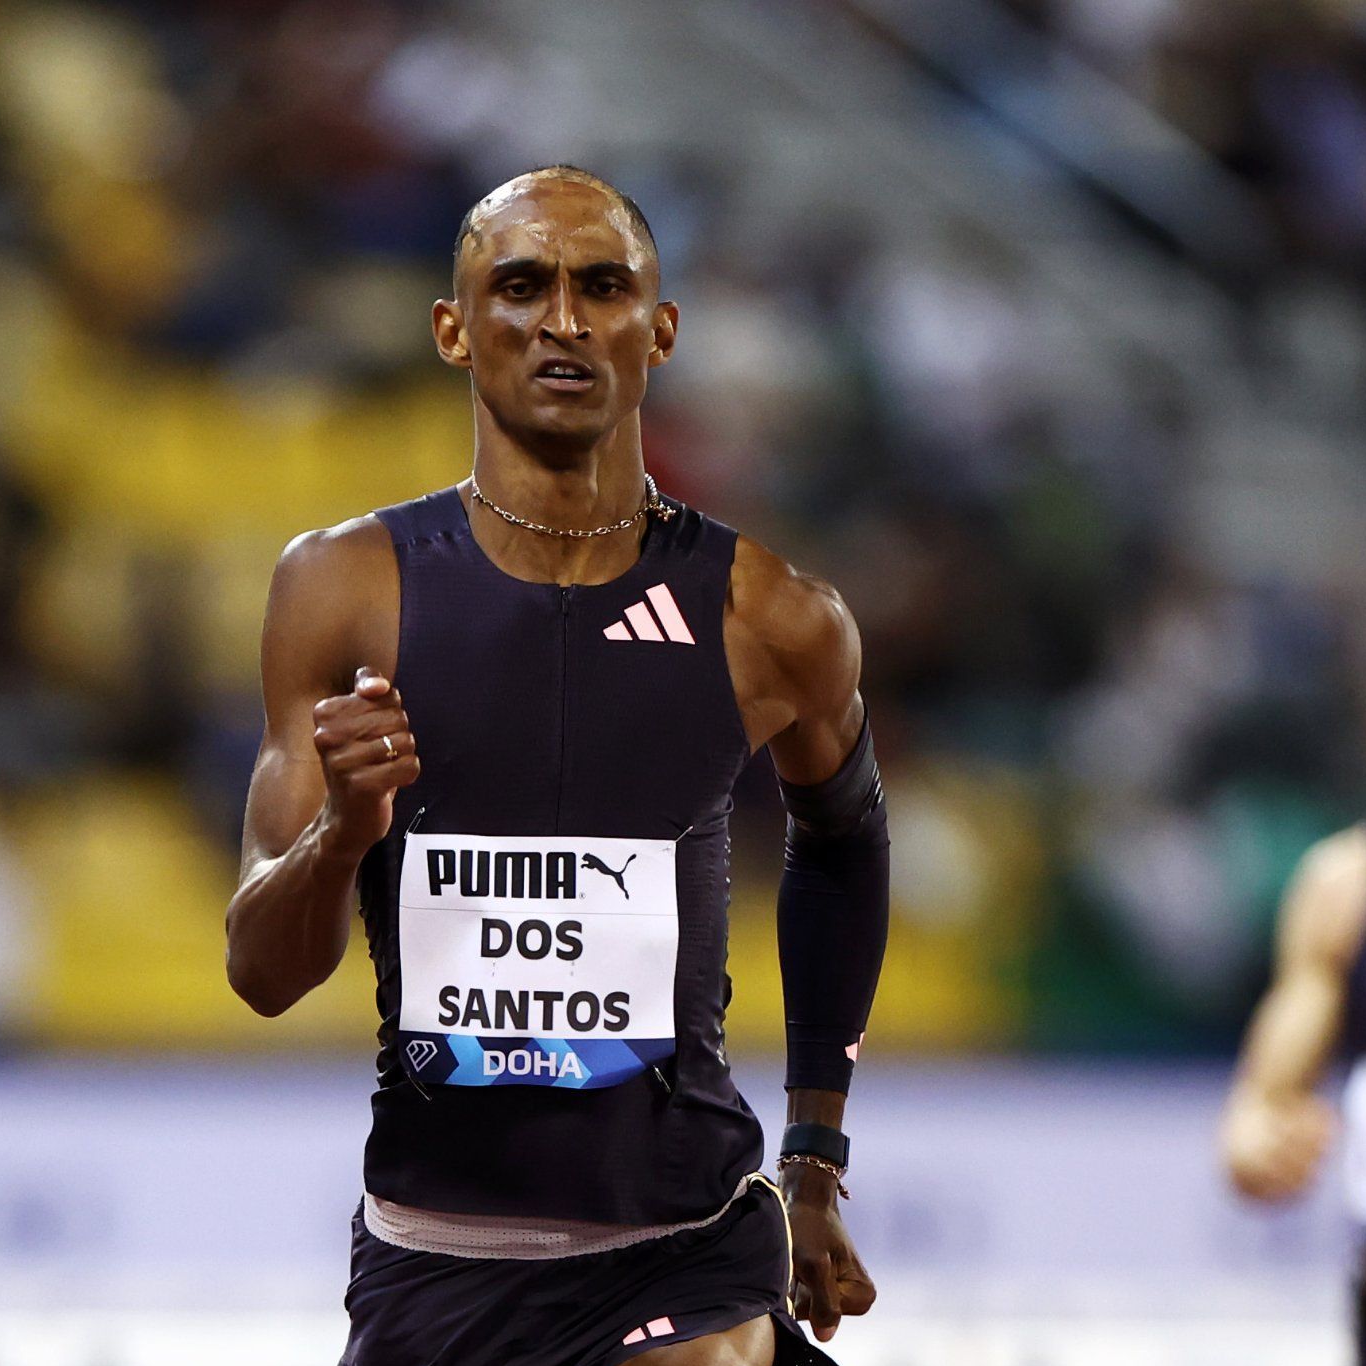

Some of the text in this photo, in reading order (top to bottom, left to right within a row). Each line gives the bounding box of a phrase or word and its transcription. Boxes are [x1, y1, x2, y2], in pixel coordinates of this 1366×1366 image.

[426, 849, 577, 900] PUMA
[480, 917, 584, 962] DOS
[437, 985, 631, 1033] SANTOS
[482, 1049, 584, 1080] DOHA
